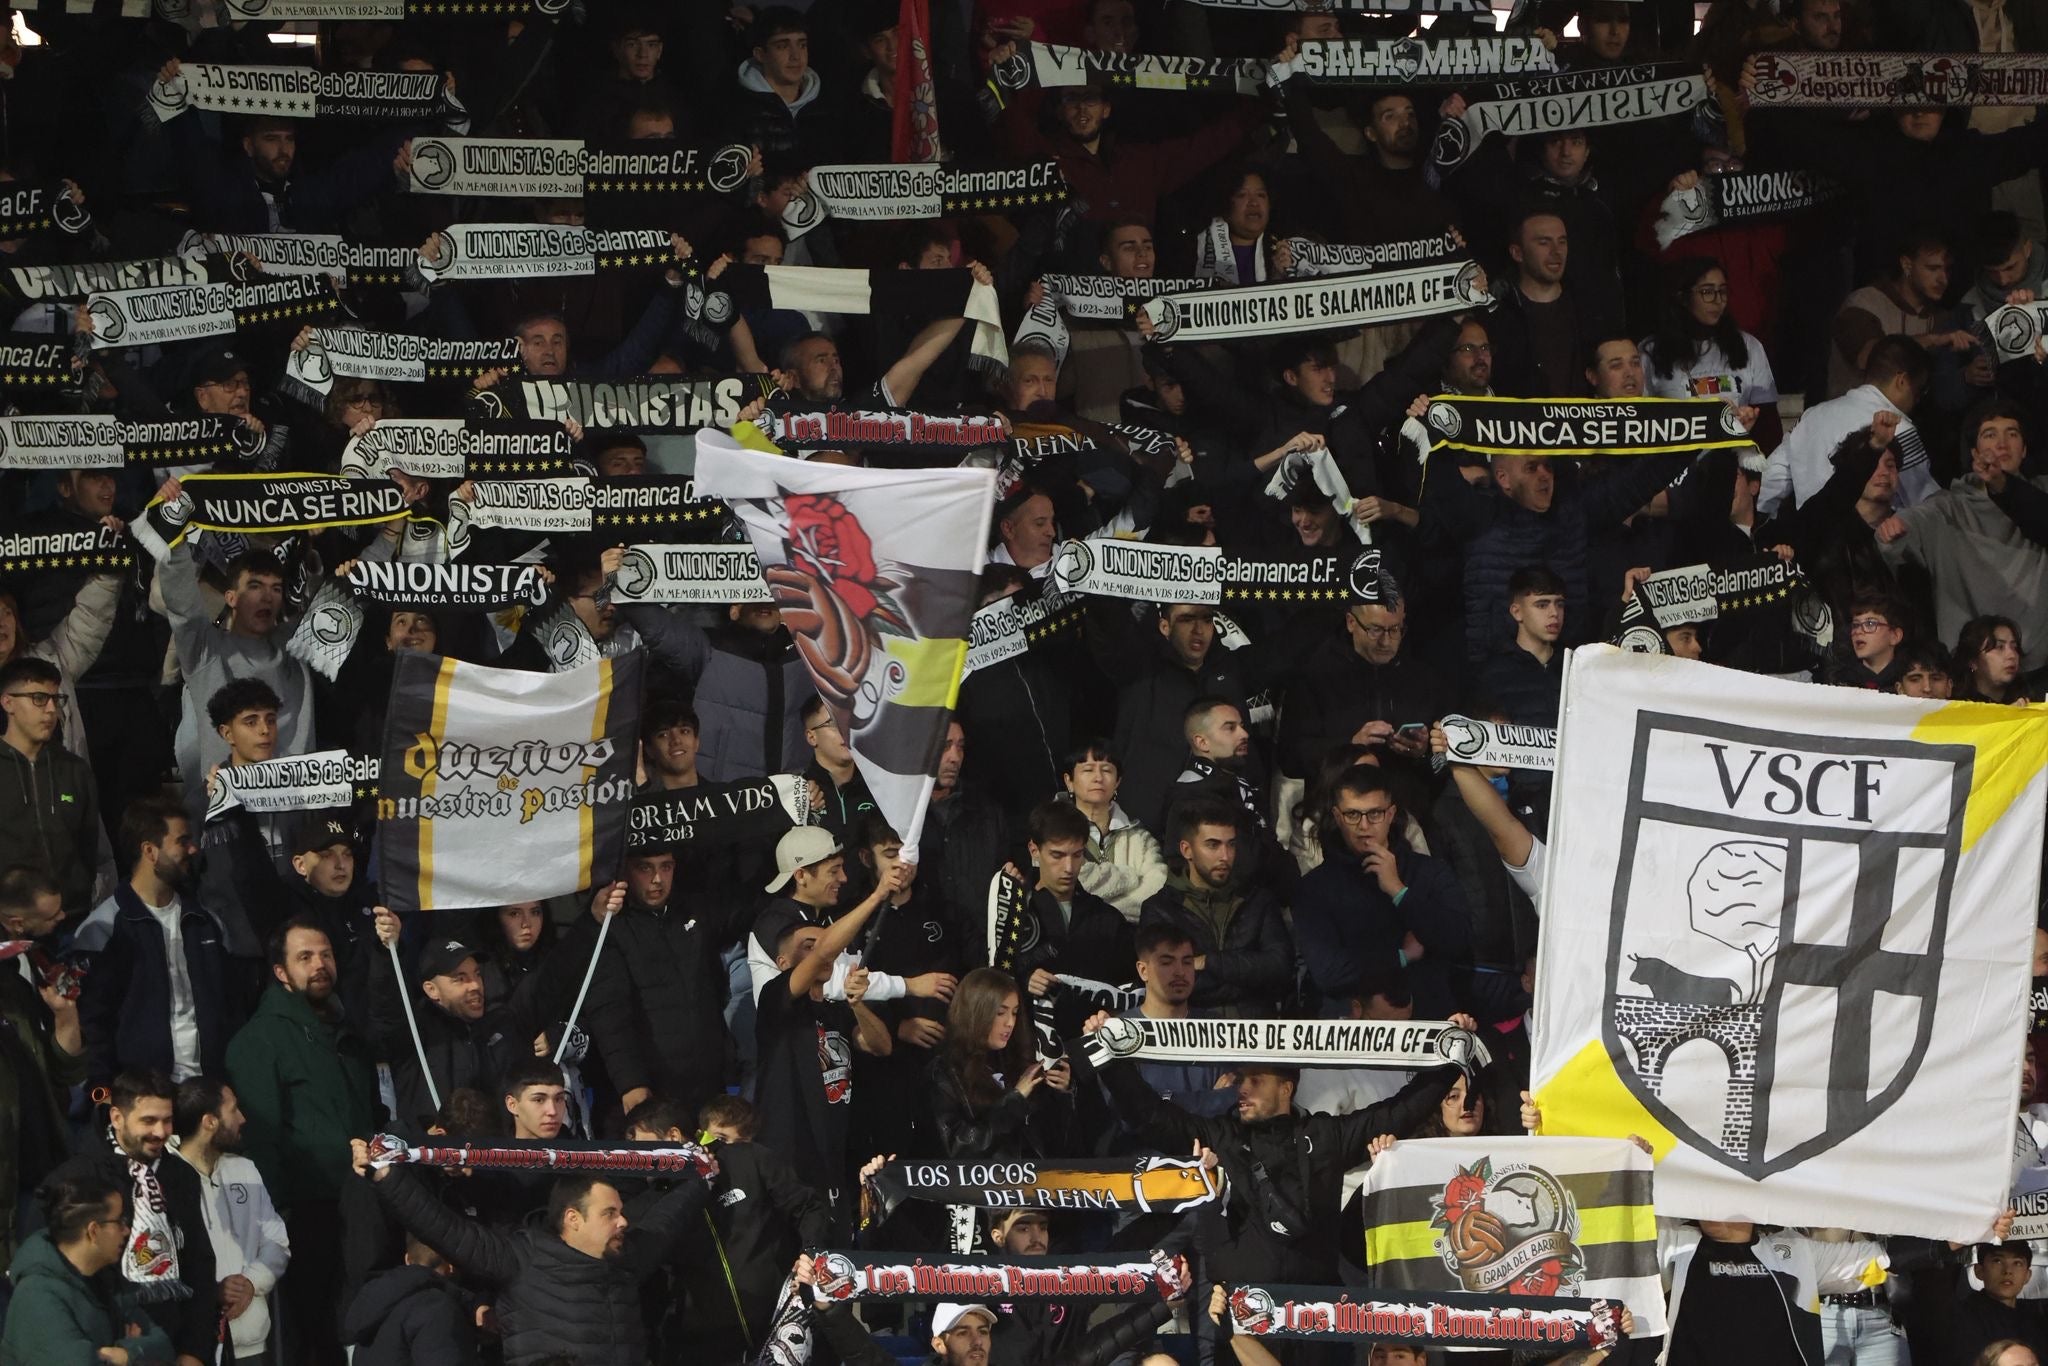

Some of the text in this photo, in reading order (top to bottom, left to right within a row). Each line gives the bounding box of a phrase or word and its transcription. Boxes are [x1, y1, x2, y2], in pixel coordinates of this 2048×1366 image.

[463, 145, 698, 176] UNIONISTAS de Salamanca C.F.
[453, 181, 464, 192] IN
[466, 181, 518, 194] MEMORIAM
[519, 182, 537, 194] VDS
[818, 161, 1058, 199] UNIONISTAS de Salamanca C.F.
[15, 188, 44, 216] C.F.
[316, 242, 338, 267] de
[465, 229, 584, 259] UNIONISTAS de
[456, 265, 466, 275] IN
[468, 263, 524, 275] MEMORIAM
[525, 262, 545, 273] VDS
[126, 287, 208, 322] UNIONISTAS
[208, 286, 226, 312] de
[226, 277, 303, 311] Salamanca
[1192, 278, 1441, 328] UNIONISTAS DE SALAMANCA CF
[128, 331, 139, 341] IN
[139, 326, 182, 340] MEMORIAM
[182, 324, 197, 336] VDS
[34, 343, 63, 369] C.F.
[398, 336, 417, 360] de
[418, 336, 501, 361] Salamanca
[521, 377, 744, 429] UNIONISTAS
[1542, 405, 1638, 419] UNIONISTAS
[11, 417, 225, 448] UNIONISTAS de Salamanca C.F.
[783, 411, 821, 442] Los
[1475, 415, 1708, 446] NUNCA SE RINDE
[438, 429, 550, 456] de Salamanca
[8, 455, 19, 465] IN
[20, 454, 65, 465] MEMORIAM
[65, 454, 83, 464] VDS
[262, 479, 352, 497] UNIONISTAS
[562, 480, 681, 510] de Salamanca
[204, 487, 404, 524] NUNCA SE RIND
[525, 515, 542, 527] VDS
[665, 551, 760, 581] UNIONISTAS
[1101, 544, 1341, 584] UNIONISTAS de Salamanca C.F.
[354, 586, 370, 597] DE
[370, 590, 448, 604] SALAMANCA
[452, 592, 487, 604] CLUB
[491, 591, 509, 603] DE
[653, 588, 740, 600] IN MEMORIAM VDS
[1088, 580, 1099, 591] IN
[1101, 582, 1153, 595] MEMORIAM
[1153, 585, 1173, 597] VDS
[1690, 575, 1708, 600] de
[1708, 563, 1784, 597] Salamanca
[998, 610, 1016, 637] de
[402, 731, 616, 781] dueños
[1485, 751, 1555, 766] IN MEMORIAM
[228, 760, 321, 790] UNIONISTAS
[323, 759, 343, 784] de
[496, 774, 519, 793] de
[1703, 742, 1888, 824] VSCF
[289, 795, 305, 806] VDS
[376, 772, 633, 824] nuestra pasión
[722, 784, 774, 815] VDS
[1155, 1021, 1423, 1053] UNIONISTAS DE SALAMANCA CF
[904, 1161, 1040, 1187] LOS LOCOS
[983, 1188, 1033, 1207] DEL
[864, 1256, 1147, 1298] Los Últimos Románticos
[1482, 1262, 1513, 1285] GRADA
[1513, 1253, 1531, 1272] DEL
[1531, 1239, 1568, 1262] BARRIO
[1285, 1293, 1576, 1343] Los Últimos Románticos
